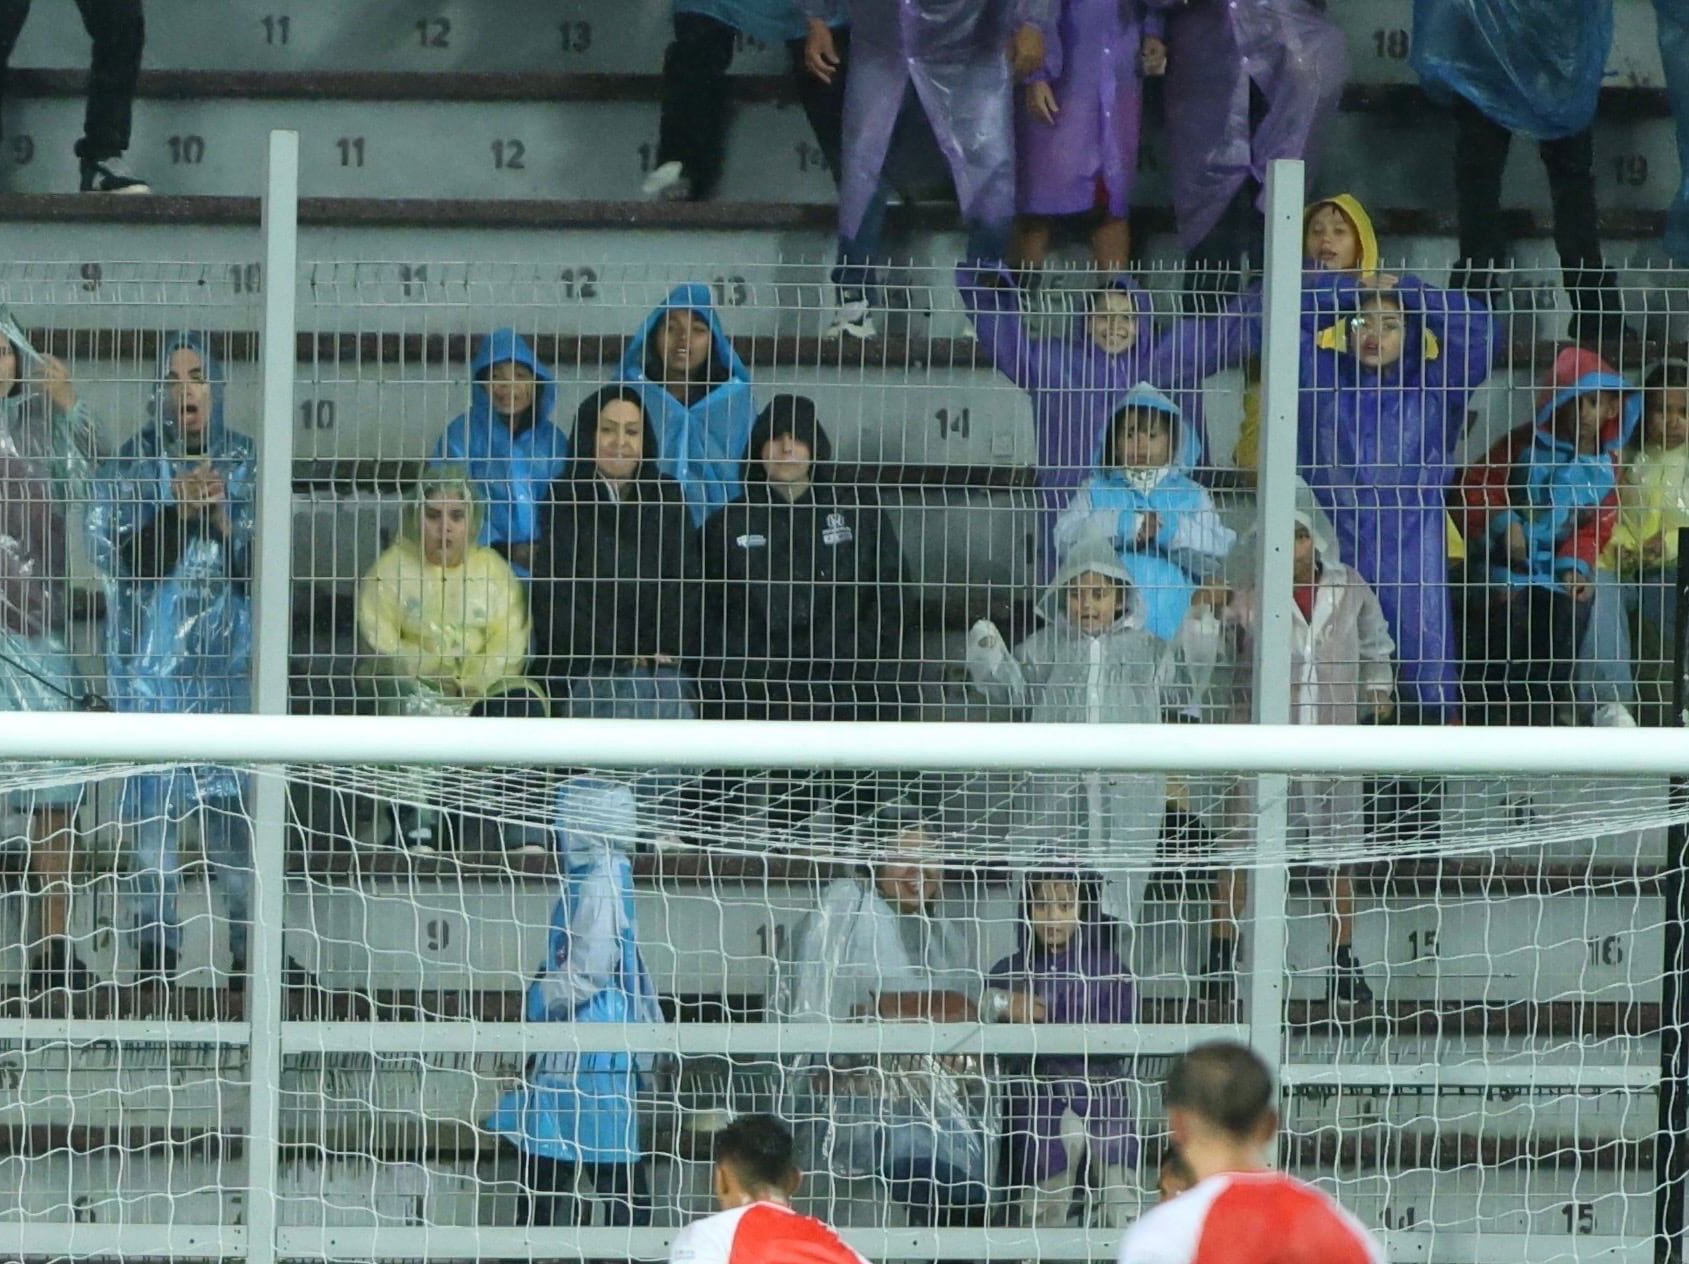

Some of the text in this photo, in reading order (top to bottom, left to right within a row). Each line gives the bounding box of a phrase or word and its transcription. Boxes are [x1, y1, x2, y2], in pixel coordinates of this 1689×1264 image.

[261, 15, 290, 45] 11
[415, 17, 452, 48] 12
[559, 21, 592, 52] 13
[1372, 30, 1409, 59] 18
[167, 136, 205, 164] 10
[335, 138, 365, 166] 11
[490, 139, 526, 169] 12
[1614, 156, 1648, 186] 19
[561, 267, 598, 298] 12
[715, 276, 748, 306] 13
[300, 399, 334, 430] 10
[935, 408, 970, 440] 14
[427, 919, 450, 950] 9
[1408, 929, 1440, 962] 15
[1586, 935, 1624, 966] 16
[1560, 1203, 1597, 1234] 15
